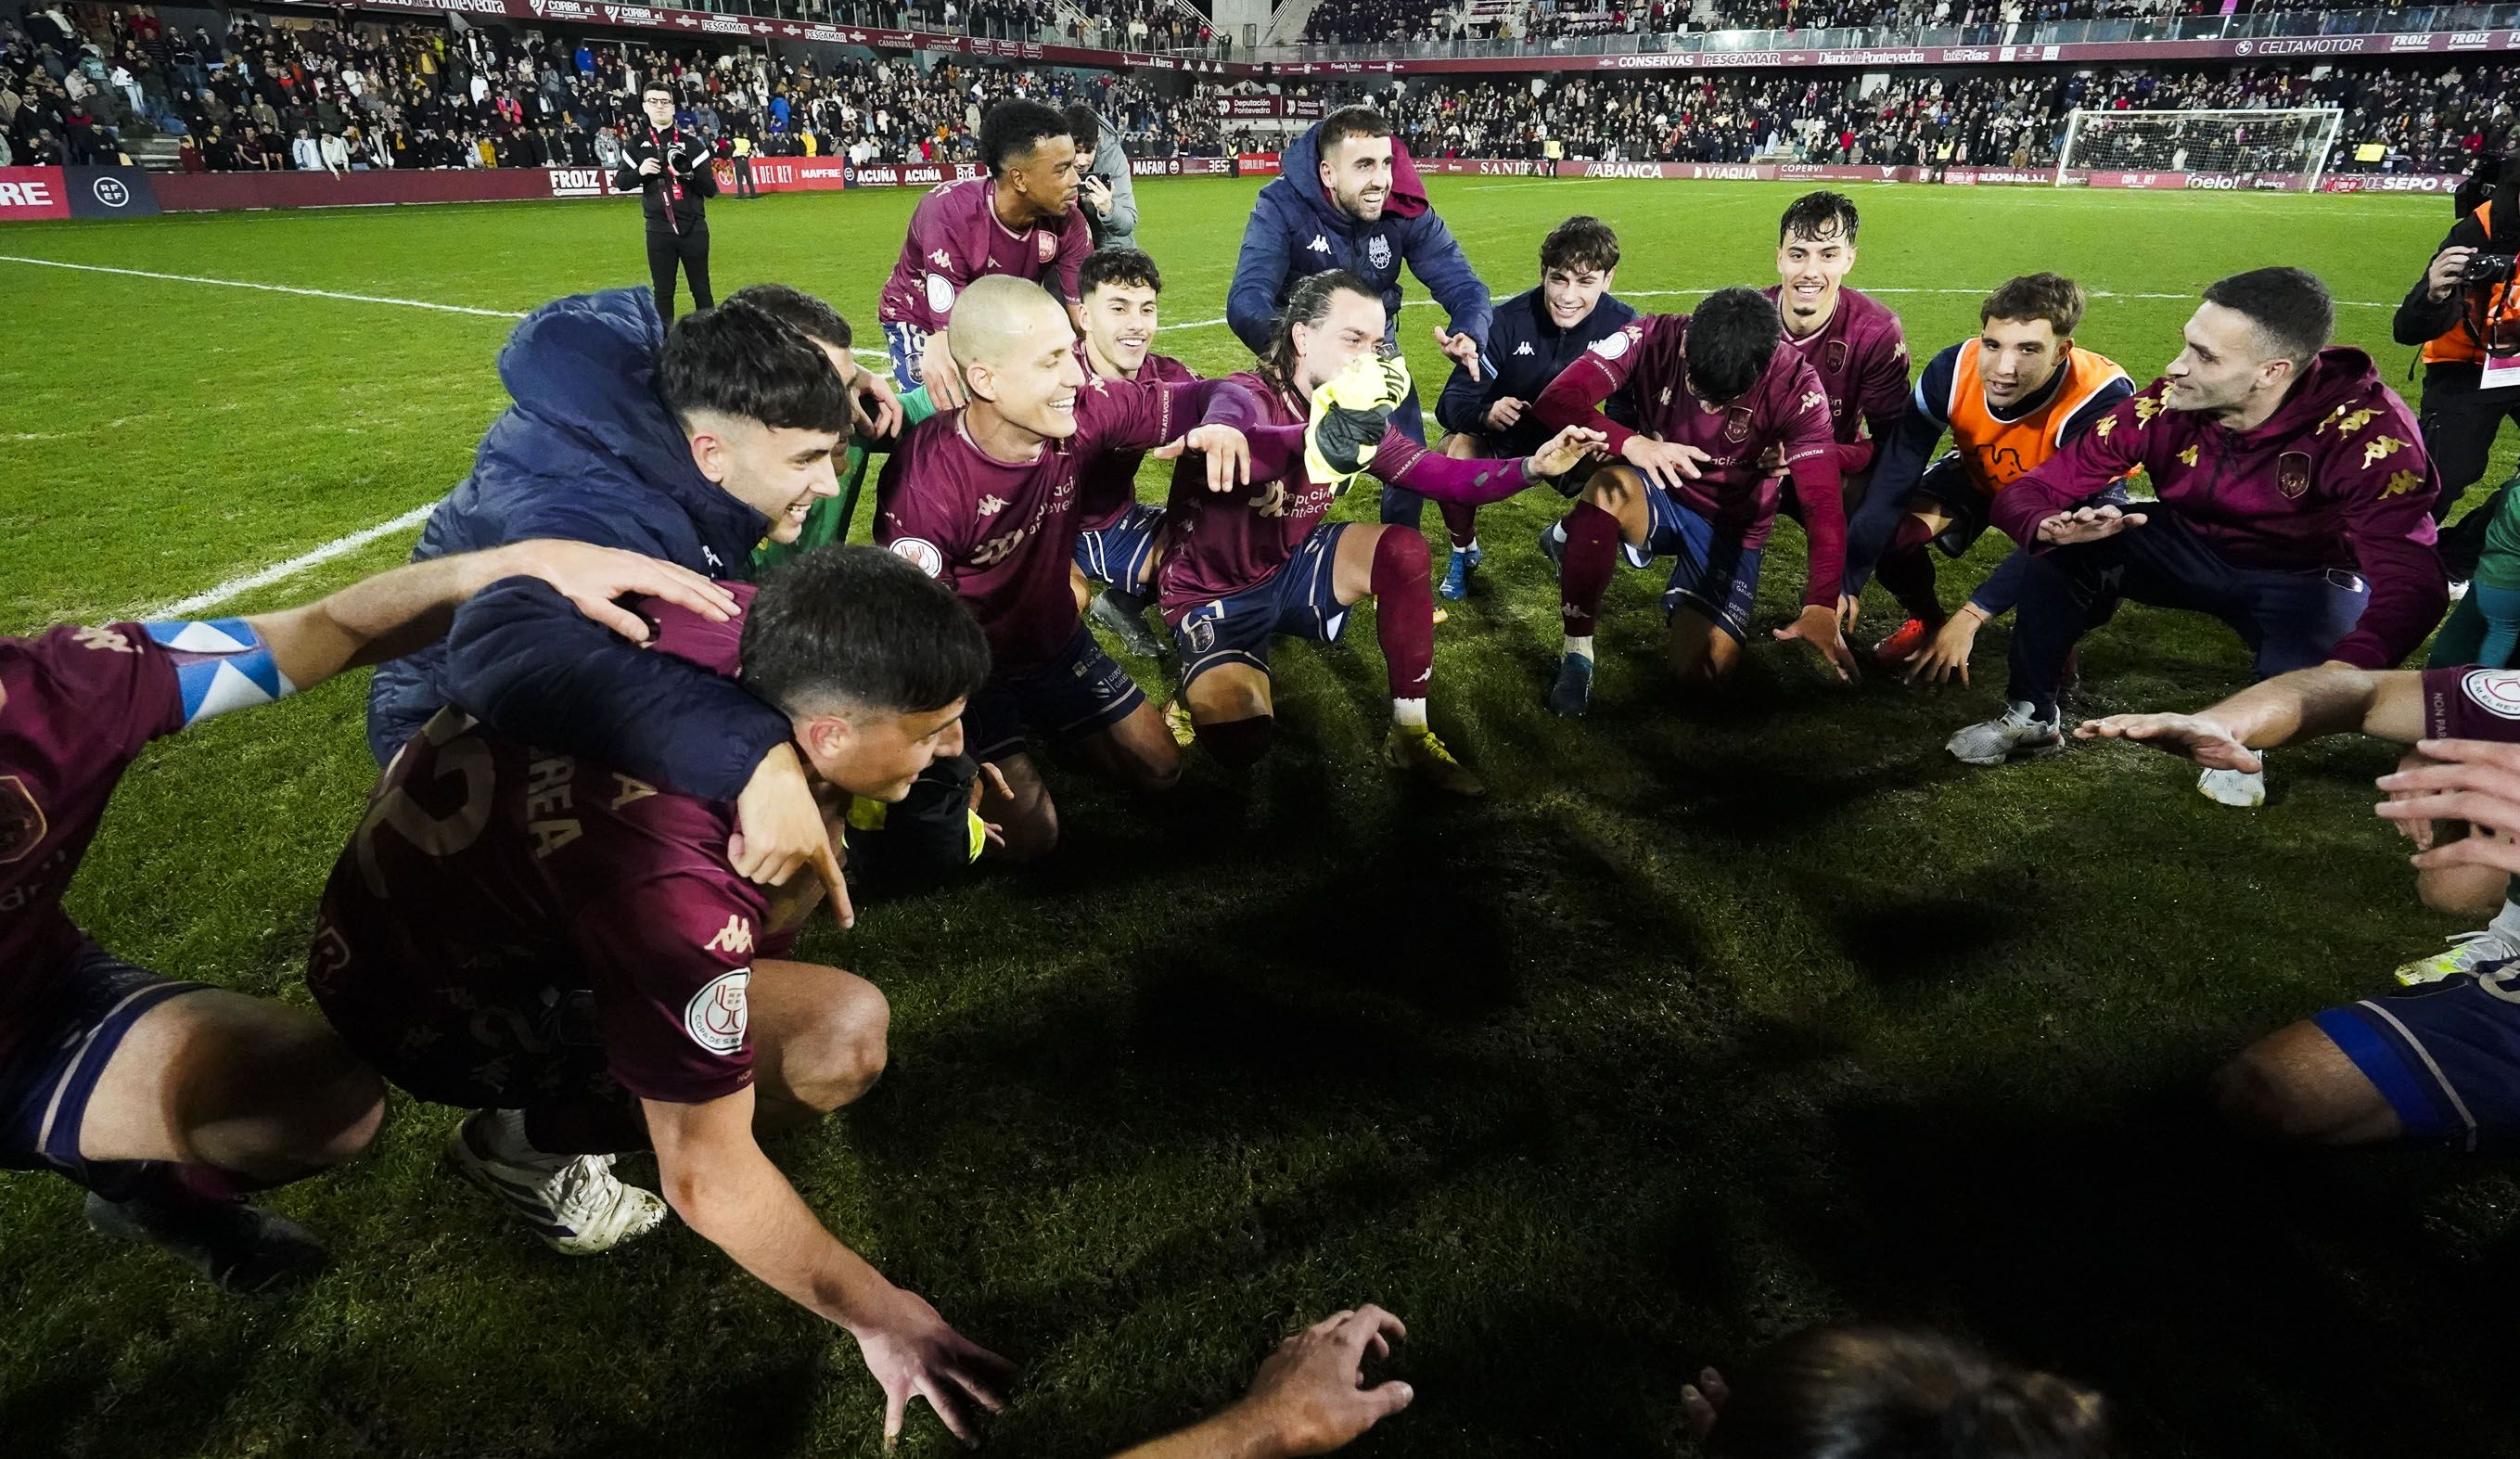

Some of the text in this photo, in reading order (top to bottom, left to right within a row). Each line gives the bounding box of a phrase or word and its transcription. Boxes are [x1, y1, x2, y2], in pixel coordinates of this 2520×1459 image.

[548, 1, 581, 13] CORBA
[621, 7, 651, 19] CORBA
[701, 19, 751, 35] PESCAMAR
[805, 29, 848, 44] PESCAMAR
[2391, 33, 2431, 45] FROIZ
[2449, 32, 2489, 45] FROIZ
[2258, 38, 2365, 55] CELTAMOTOR
[1149, 57, 1156, 68] A
[1618, 52, 1782, 68] CONSERVAS PESCAMAR
[1861, 49, 1925, 64] Pontevedra
[1234, 98, 1271, 108] Deputación
[1234, 107, 1271, 115] Pontevedra
[760, 166, 776, 185] DEL
[776, 165, 793, 184] REY
[800, 168, 842, 179] MAPFRE
[857, 167, 898, 183] ACUÑA
[904, 166, 942, 182] ACUÑA
[1132, 160, 1167, 175] MAFARI
[1593, 163, 1664, 179] ABANCA
[1781, 163, 1823, 173] COPERVI
[549, 170, 601, 188] FROIZ
[2383, 177, 2438, 191] SEPO
[100, 184, 120, 192] RF
[104, 192, 122, 200] EF
[2433, 692, 2445, 717] NON
[694, 1014, 709, 1040] COPA
